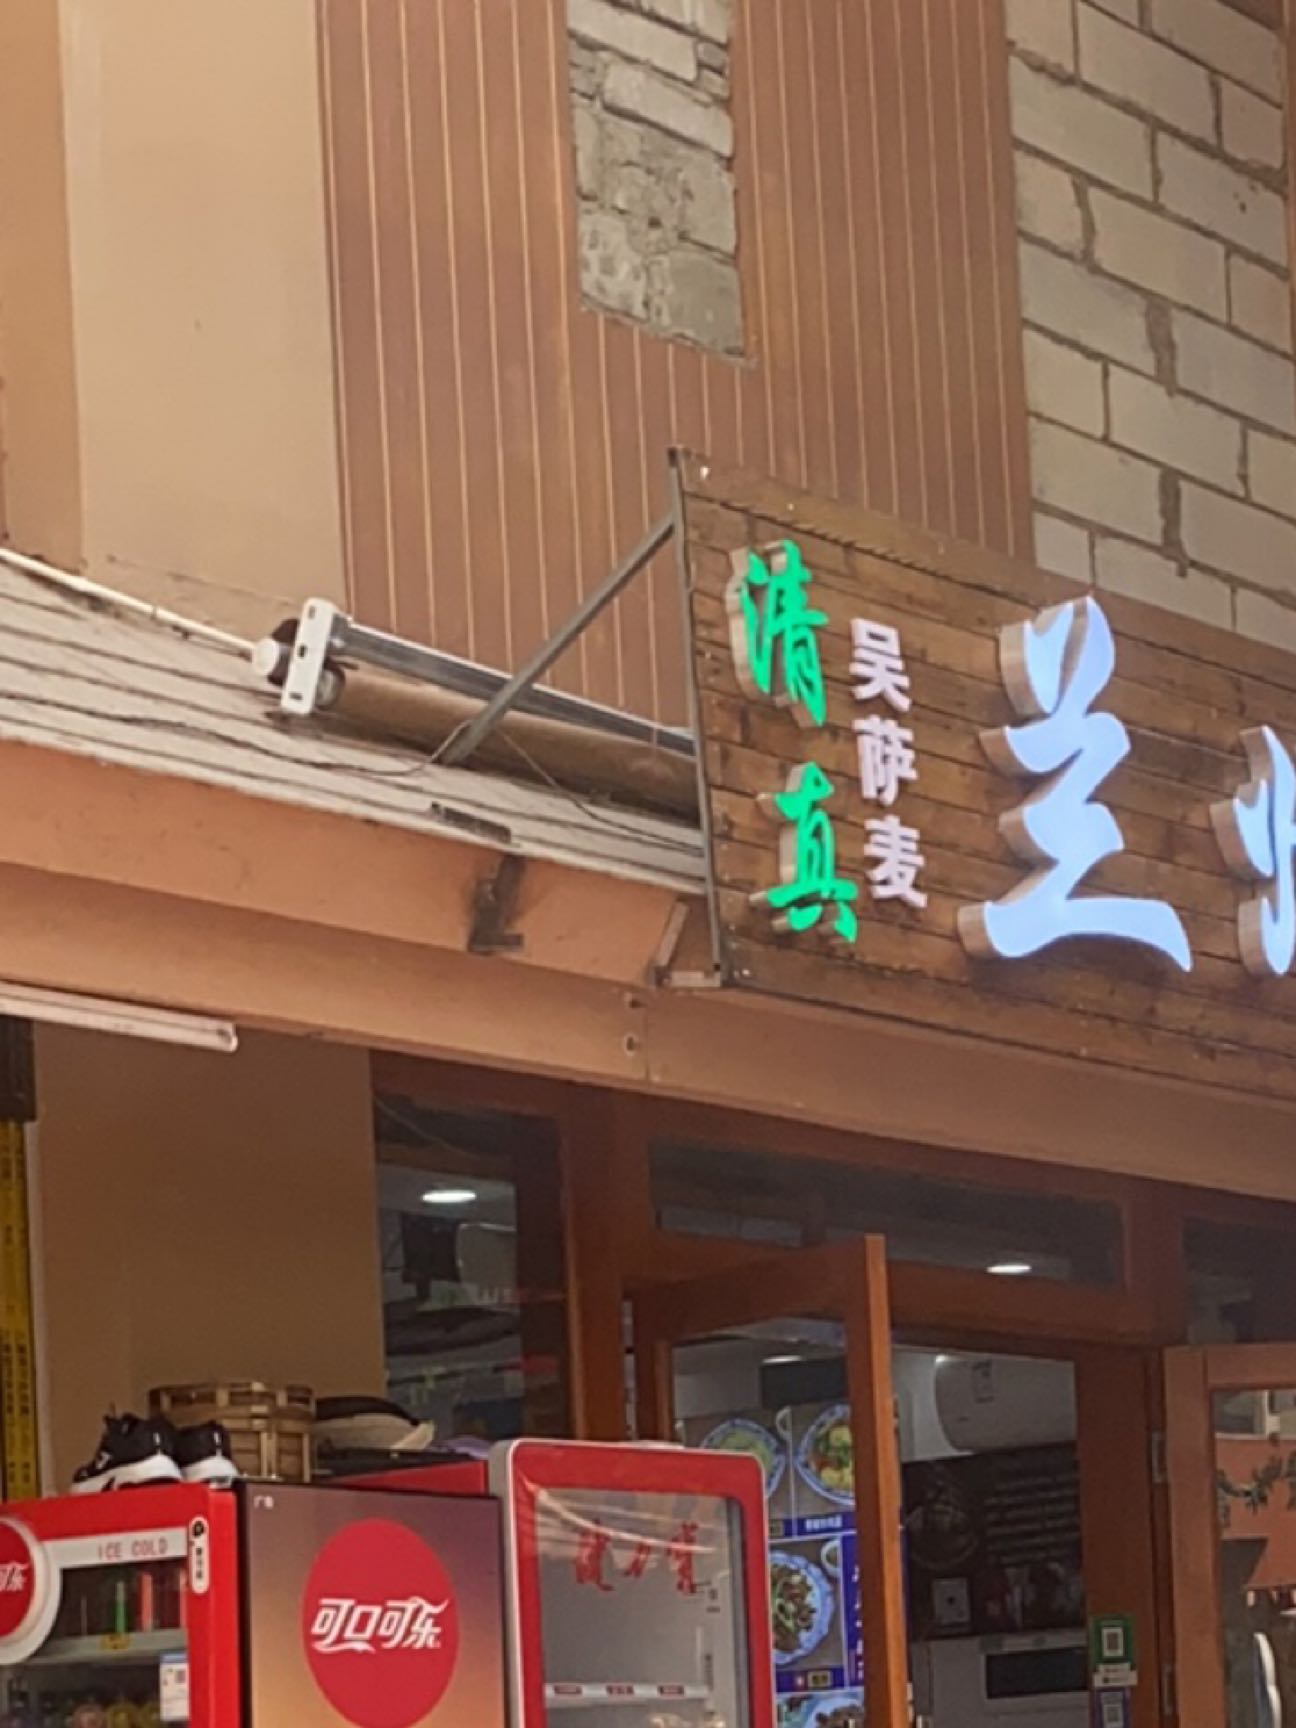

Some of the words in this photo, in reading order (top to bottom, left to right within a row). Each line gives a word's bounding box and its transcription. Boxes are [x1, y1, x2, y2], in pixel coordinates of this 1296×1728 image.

[736, 538, 858, 943] 清真
[848, 617, 928, 908] 吴萨麦
[131, 1537, 168, 1557] COLD
[310, 1595, 450, 1655] 可口可乐
